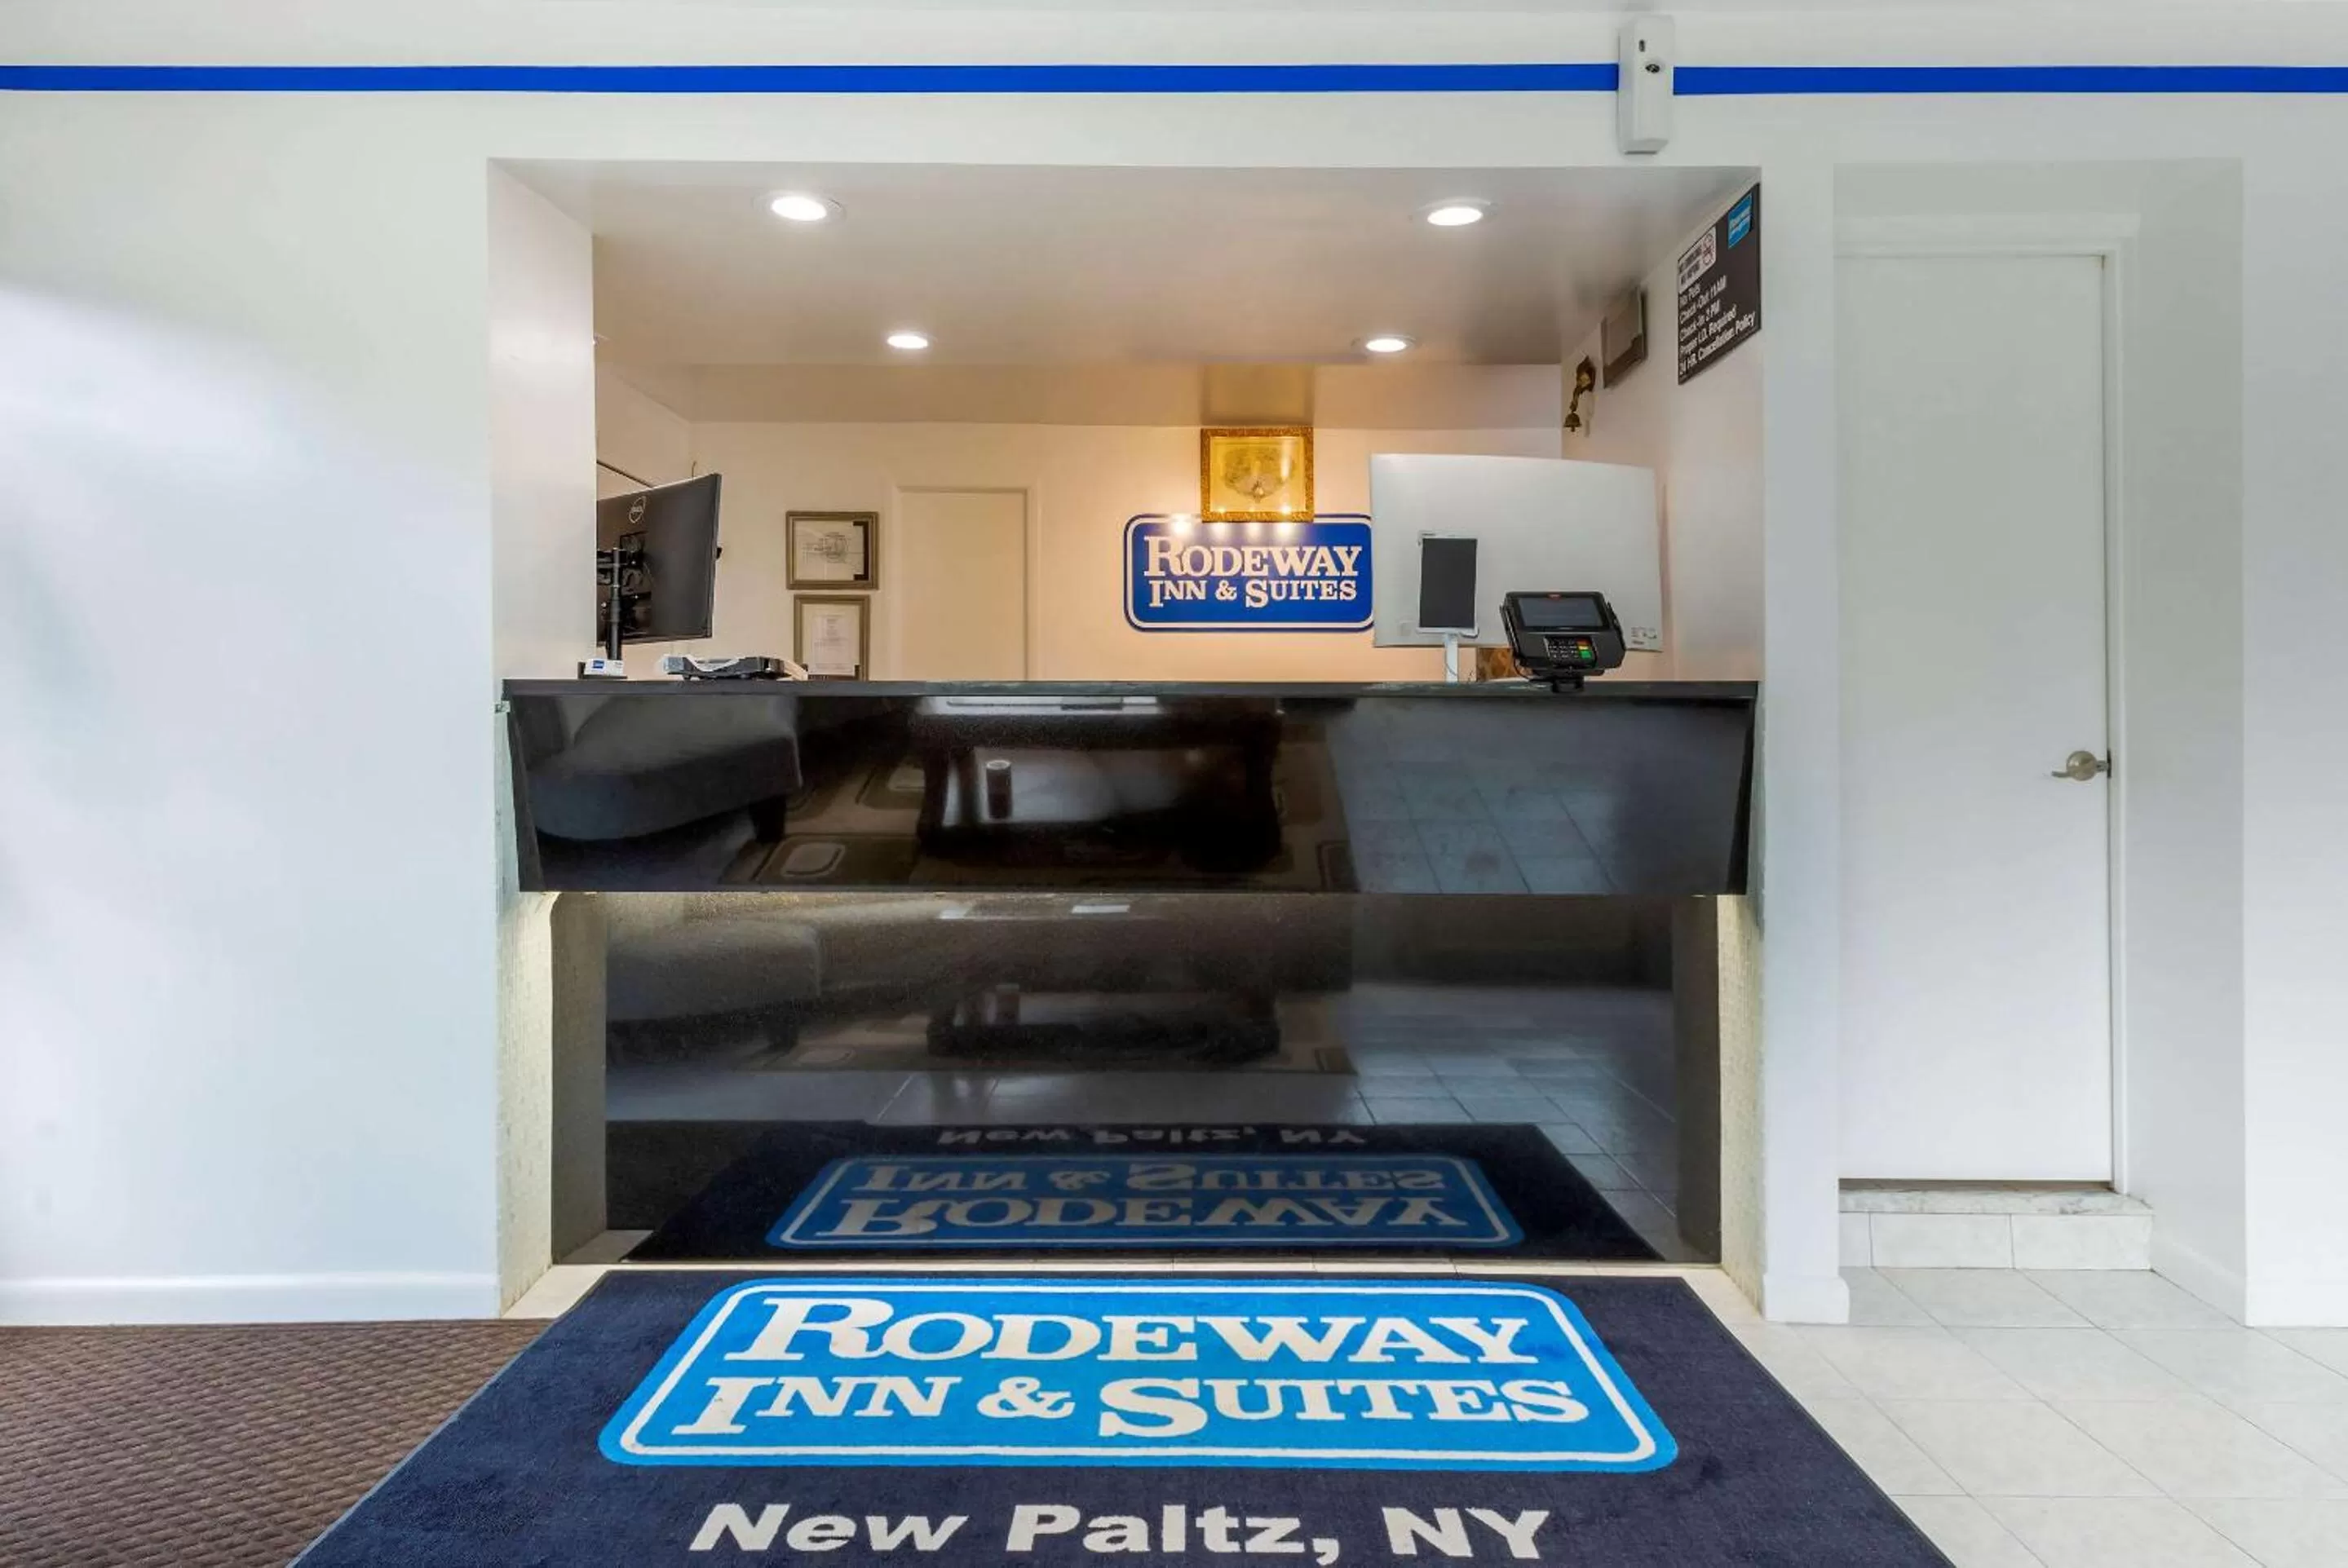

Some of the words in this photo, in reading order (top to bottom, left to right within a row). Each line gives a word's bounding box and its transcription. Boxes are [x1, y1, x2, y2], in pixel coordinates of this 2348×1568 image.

[1735, 310, 1756, 335] Policy
[1143, 535, 1363, 577] RODEWAY
[1148, 580, 1206, 607] INN
[1215, 579, 1237, 600] &
[1245, 580, 1357, 608] SUITES
[724, 1297, 1539, 1363] RODEWAY
[671, 1376, 962, 1435] INN
[977, 1376, 1076, 1419] &
[1098, 1377, 1590, 1438] SUITES
[688, 1503, 970, 1553] New
[1006, 1504, 1340, 1566] Paltz,
[1381, 1506, 1550, 1561] NY
